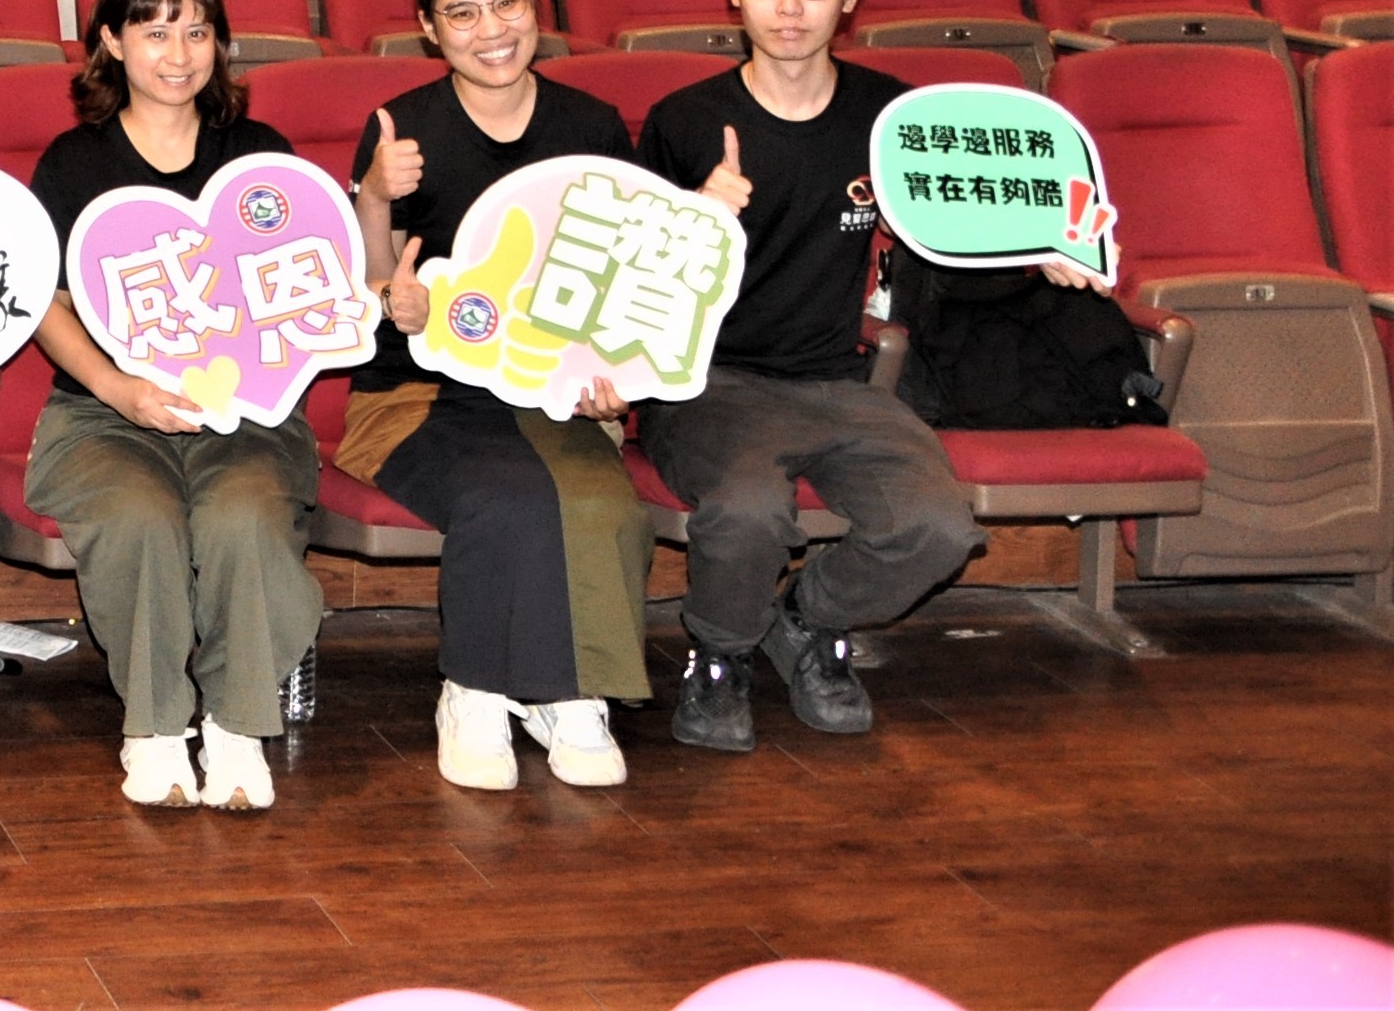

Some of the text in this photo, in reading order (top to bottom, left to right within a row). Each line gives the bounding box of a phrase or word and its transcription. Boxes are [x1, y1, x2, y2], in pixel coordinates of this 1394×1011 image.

[897, 123, 1055, 159] 邊學邊服務
[98, 226, 367, 365] 感恩
[529, 174, 728, 380] 讚
